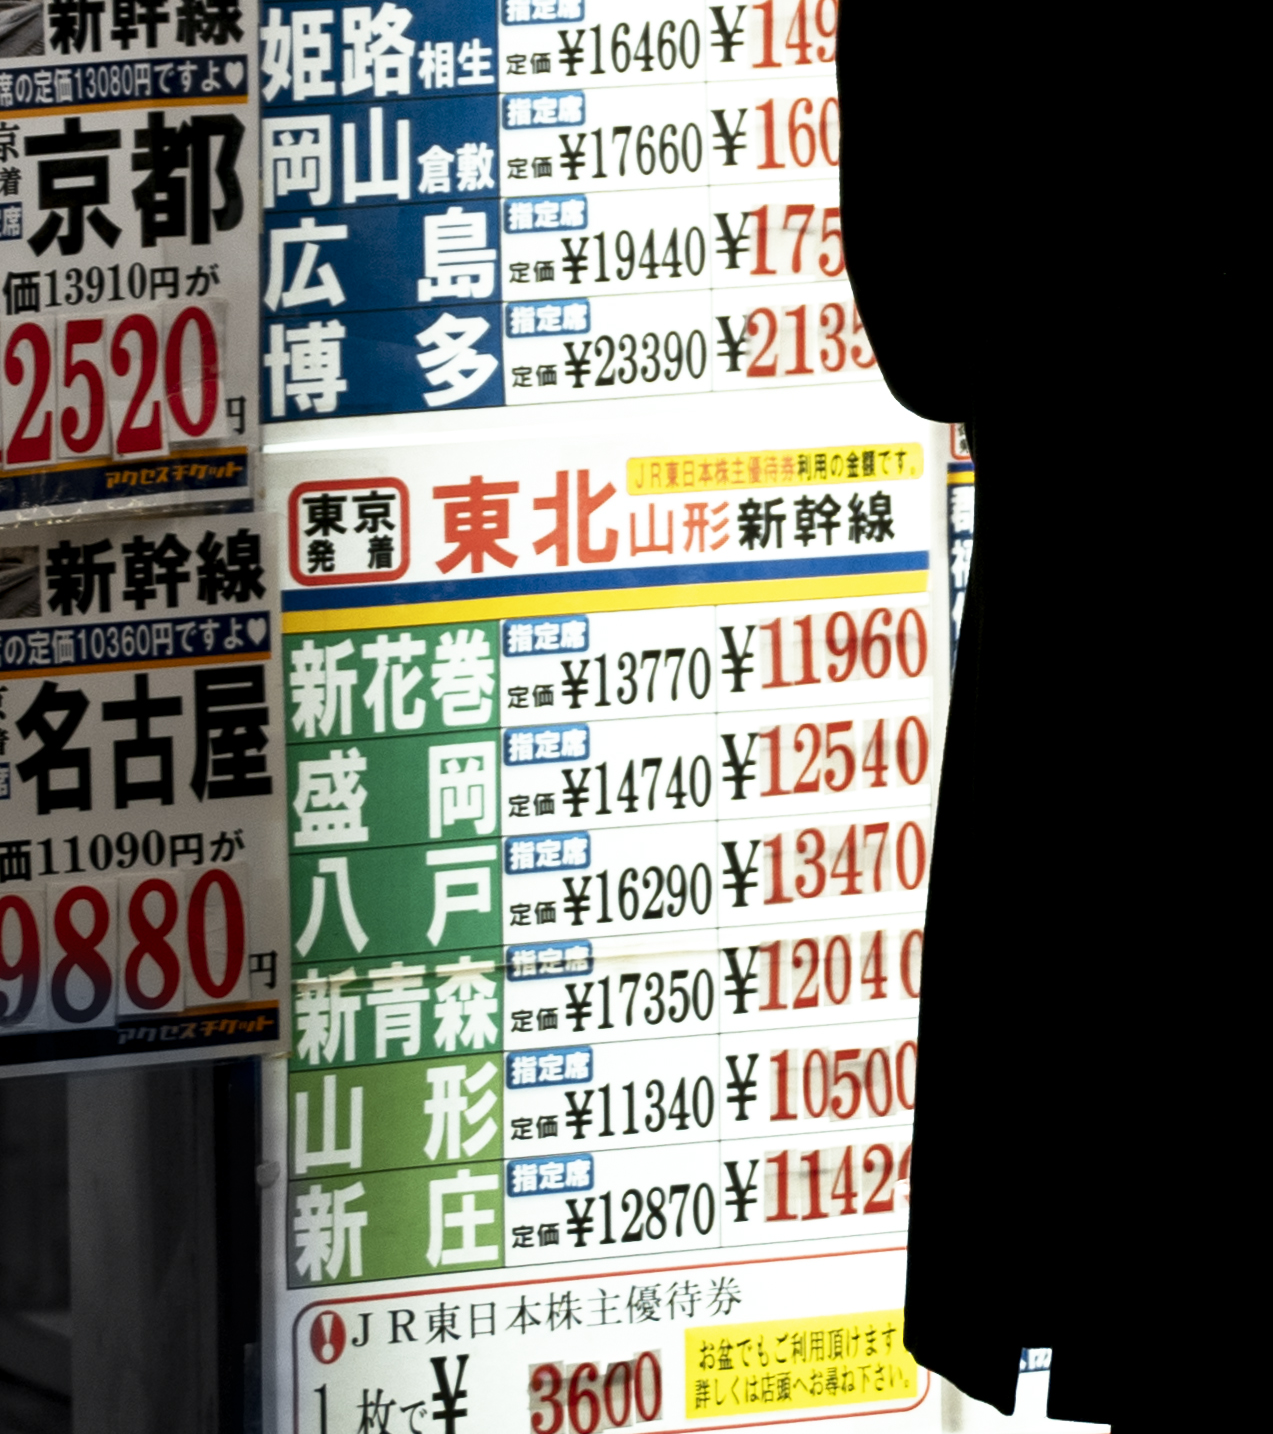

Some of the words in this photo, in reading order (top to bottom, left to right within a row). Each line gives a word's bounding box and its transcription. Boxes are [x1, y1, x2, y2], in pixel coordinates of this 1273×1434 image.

[24, 110, 247, 257] 京都
[45, 526, 267, 617] 新幹線
[289, 629, 496, 741] 新花巻
[721, 606, 929, 695] ¥11960
[14, 664, 274, 816] 名古屋
[721, 714, 930, 802] ¥12540
[721, 819, 927, 909] ¥13470
[293, 952, 499, 1066] 新青森
[351, 1276, 743, 1350] JR東日本株主優待券
